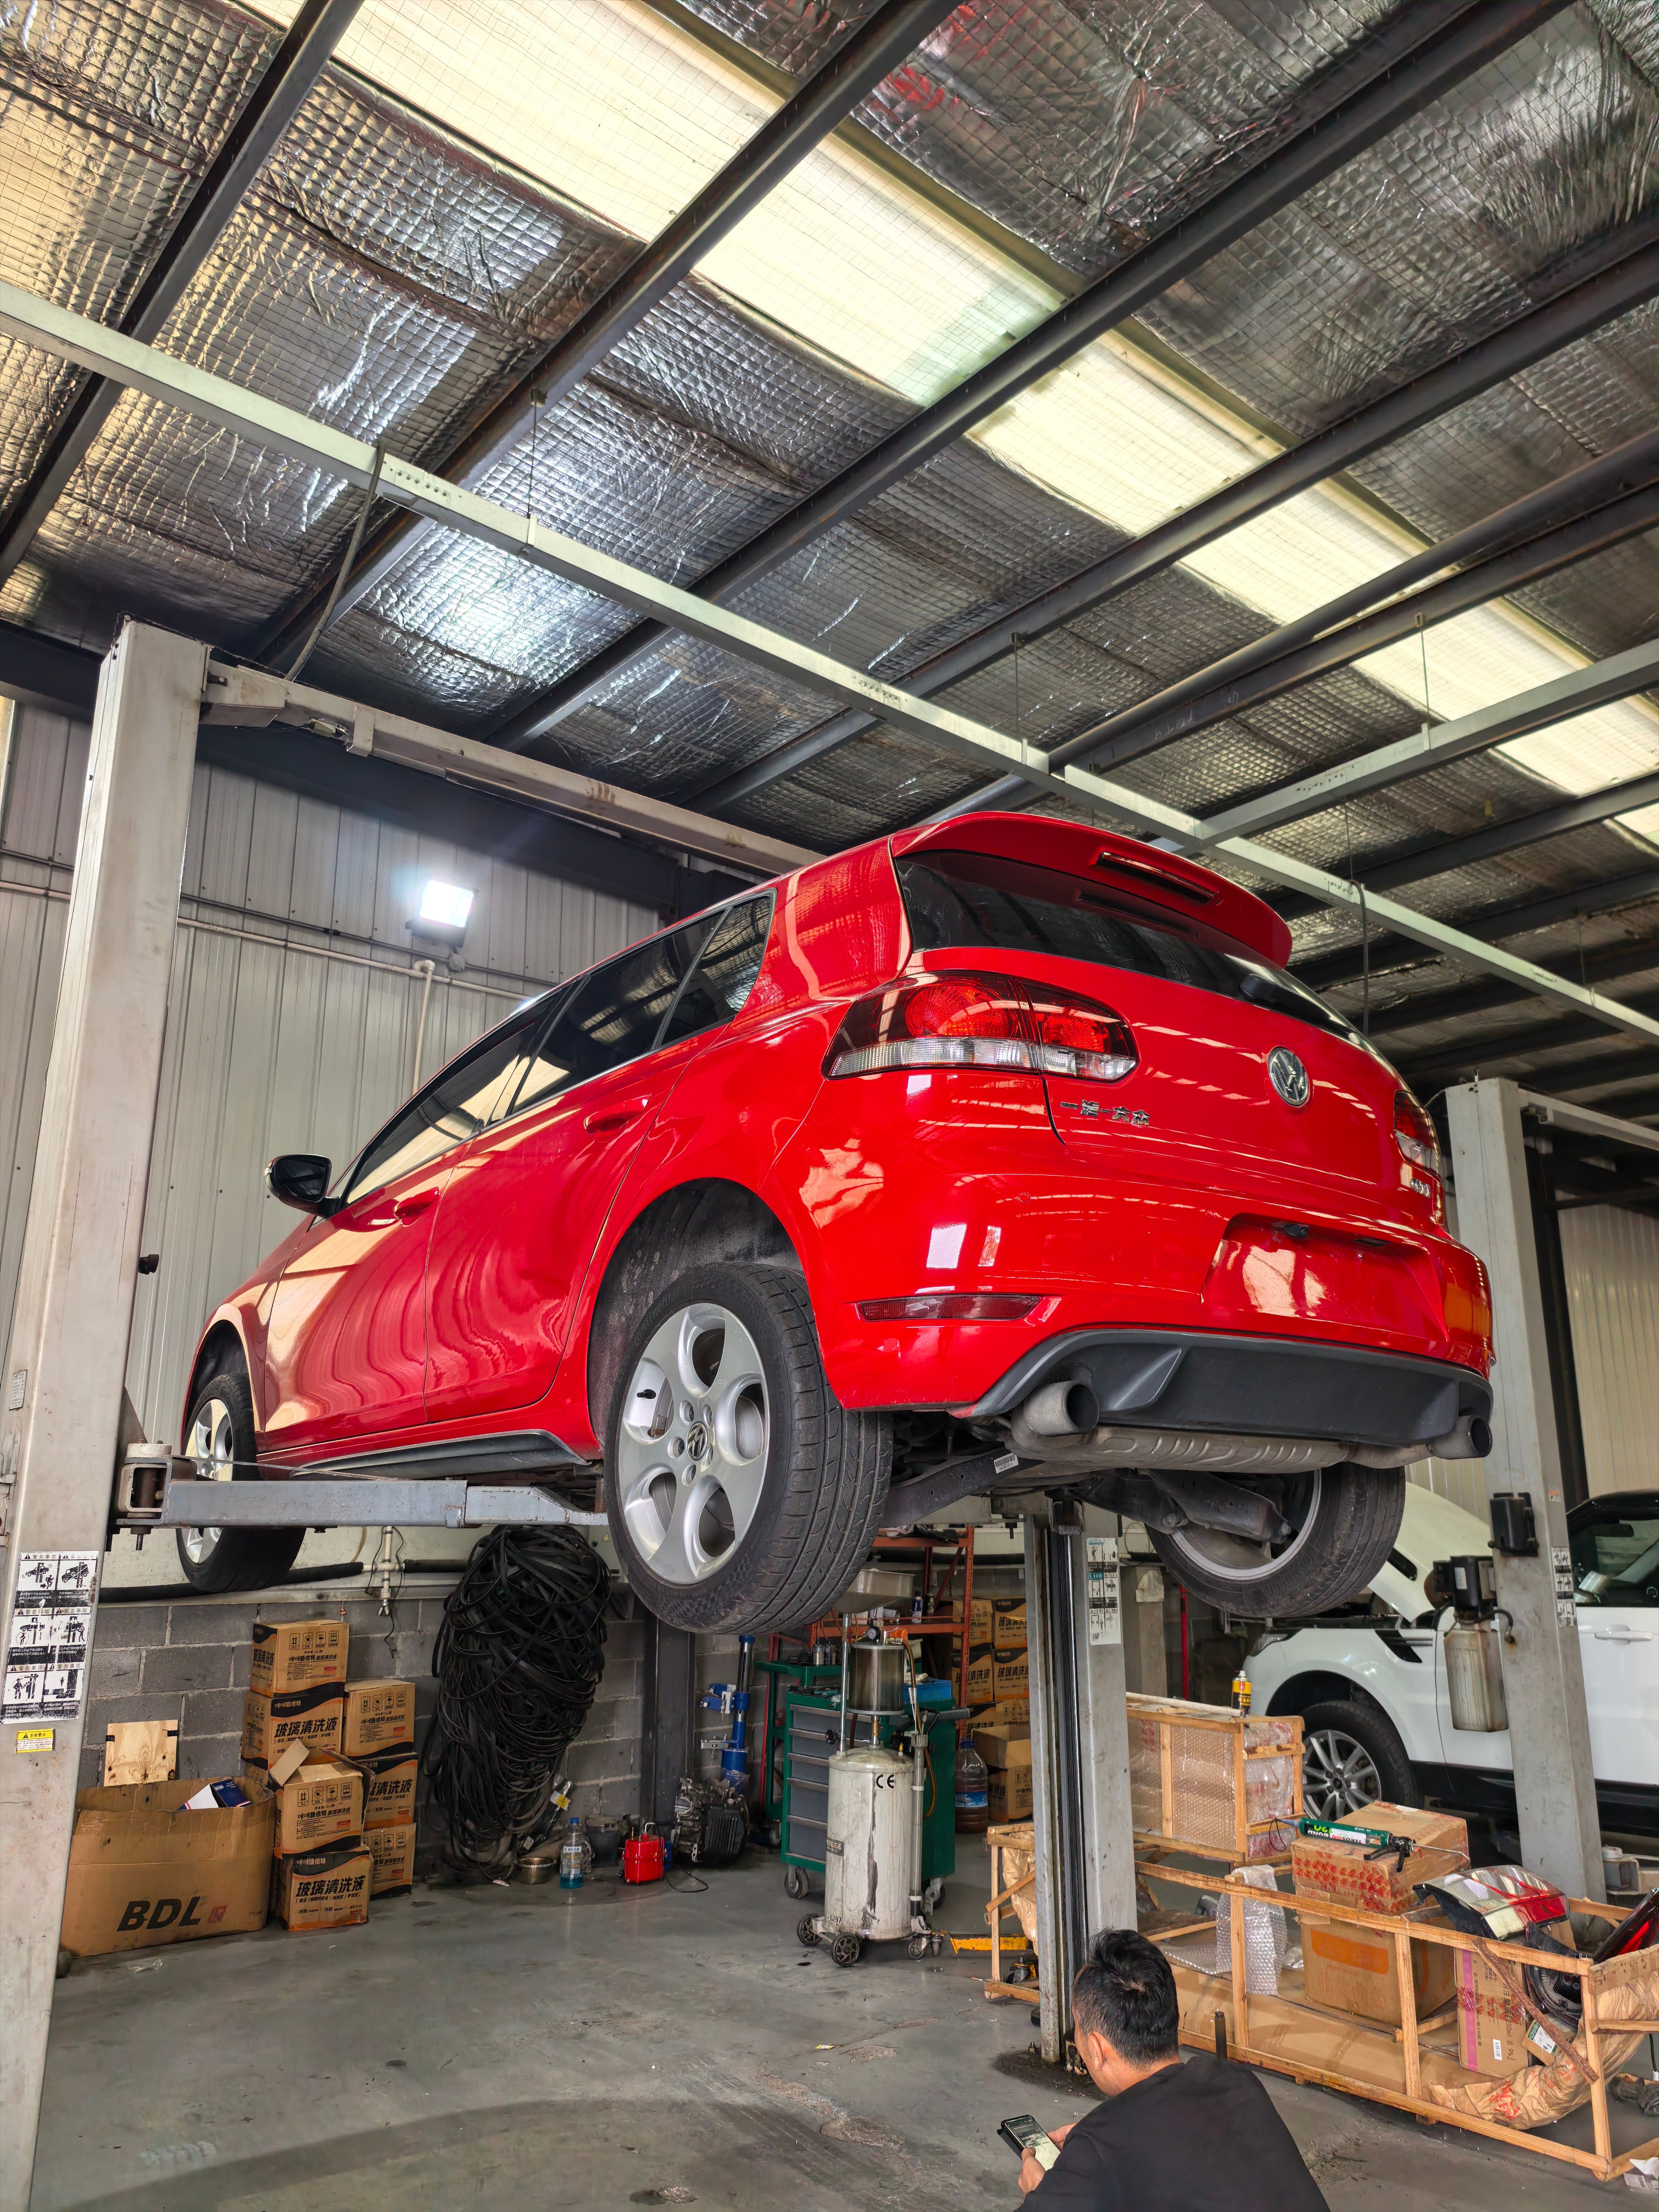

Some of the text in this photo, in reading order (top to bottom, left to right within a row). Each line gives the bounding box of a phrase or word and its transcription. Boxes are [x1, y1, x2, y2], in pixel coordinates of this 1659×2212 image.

[1060, 1099, 1150, 1126] 一汽-大众
[274, 1716, 338, 1738] 玻璃清洗液
[876, 1774, 894, 1789] CE
[295, 1875, 366, 1897] 玻璃清洗液
[116, 1896, 201, 1932] BDL
